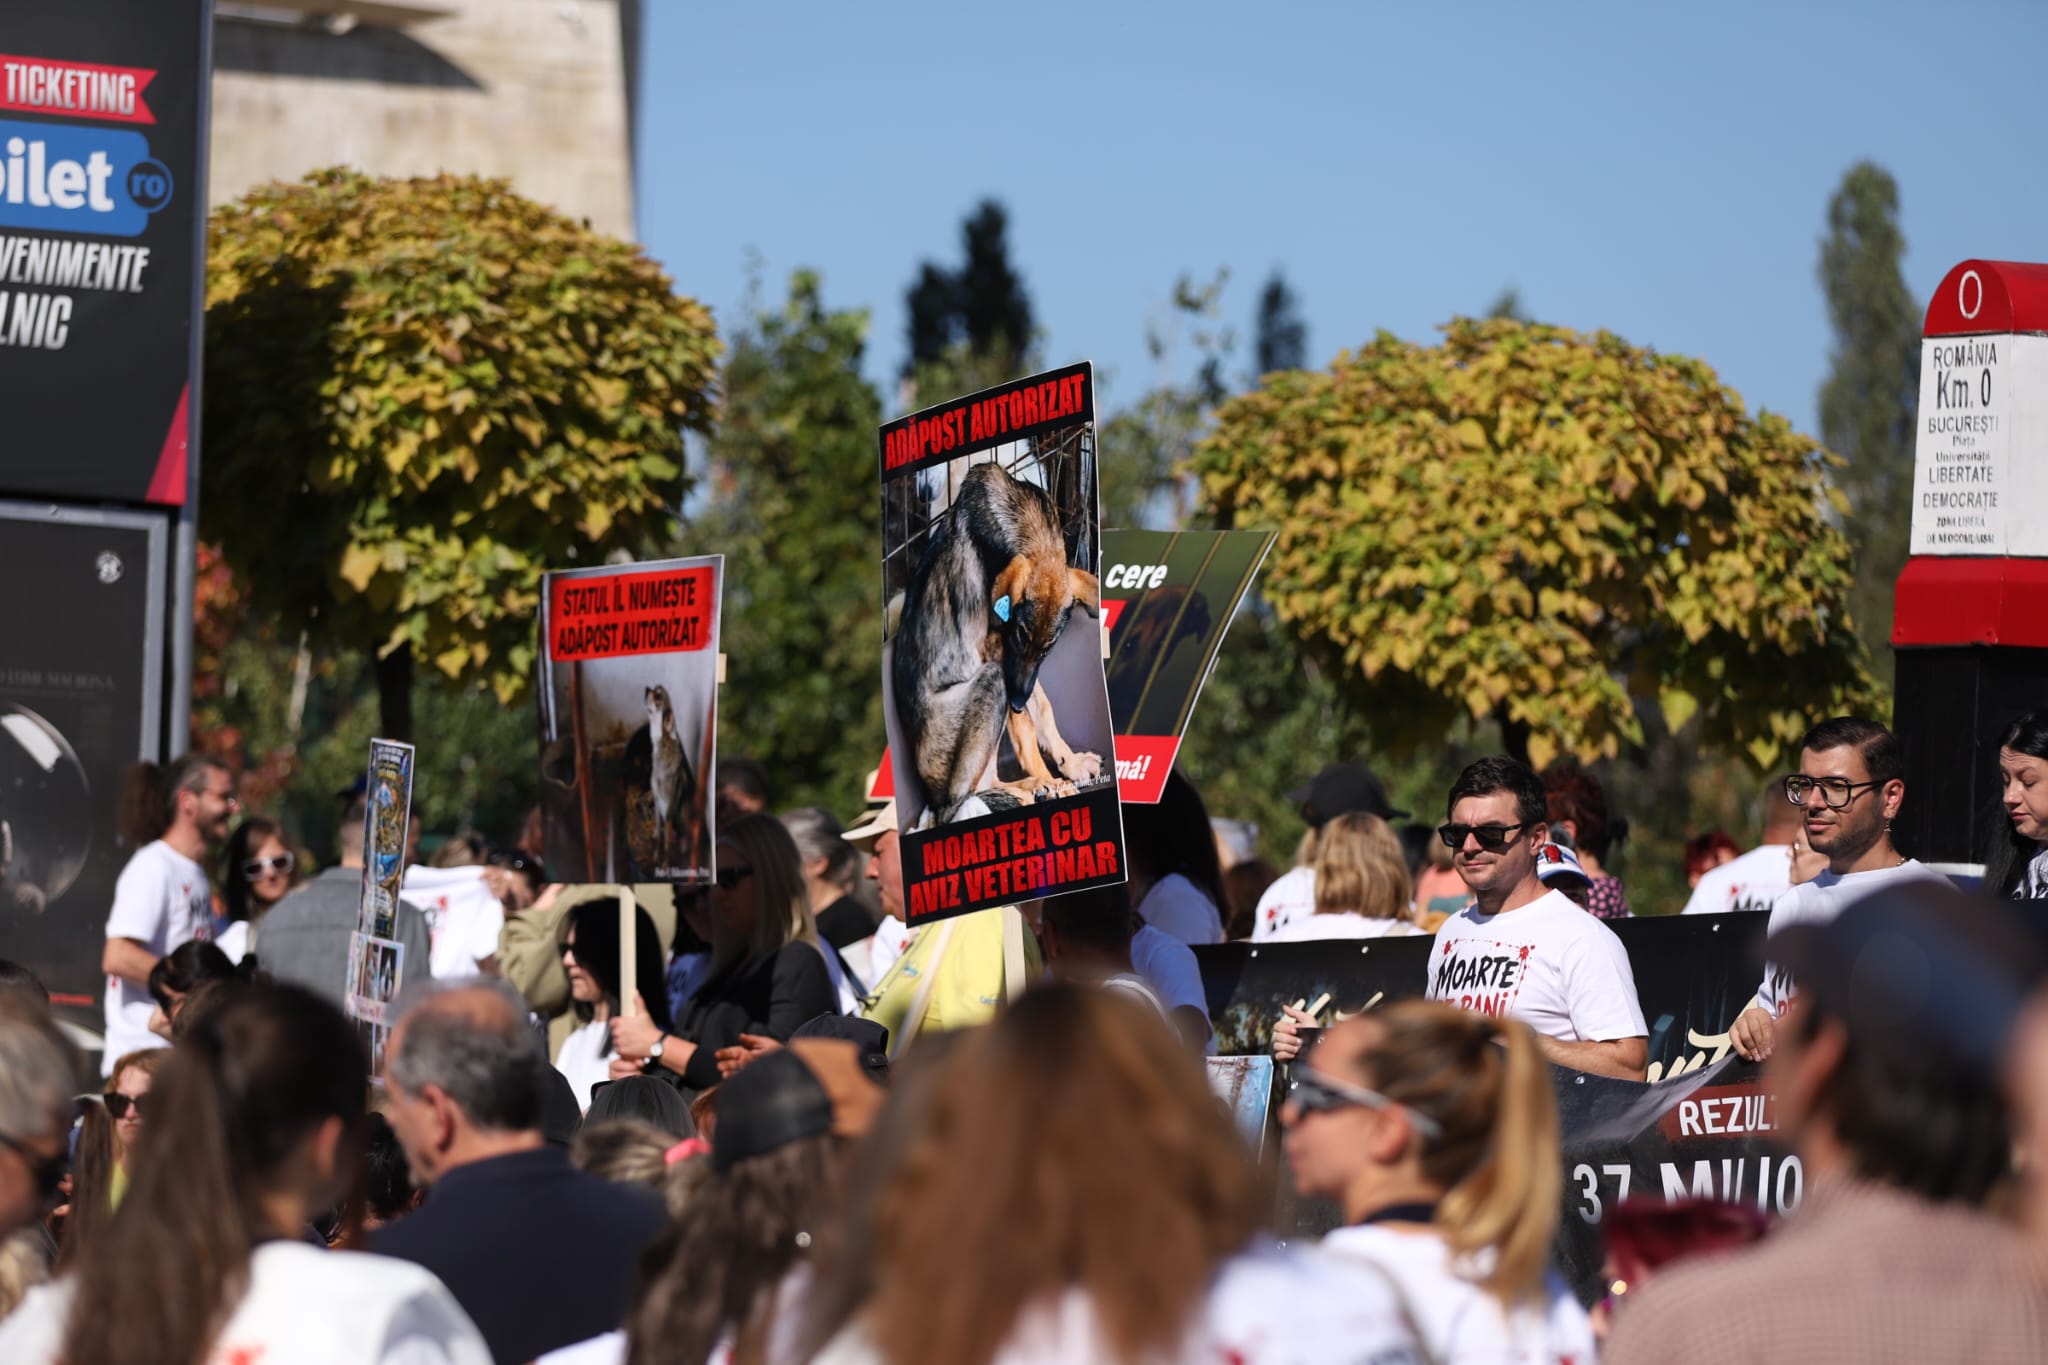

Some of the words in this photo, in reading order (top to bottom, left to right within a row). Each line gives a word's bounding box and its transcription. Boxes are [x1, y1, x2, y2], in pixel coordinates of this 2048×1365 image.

[4, 62, 136, 116] TICKETING
[0, 136, 115, 212] ilet
[132, 172, 165, 199] ro
[1933, 338, 1998, 369] ROMÂNIA
[1981, 368, 1991, 407] 0
[885, 407, 967, 471] ADĂPOST
[970, 373, 1085, 443] AUTORIZAT
[1928, 465, 1993, 484] LIBERTATE
[1105, 563, 1168, 589] cere
[563, 585, 609, 616] STATUL
[557, 619, 618, 655] ADĂPOST
[620, 615, 699, 651] AUTORIZAT
[922, 816, 1046, 876] MOARTEA
[1051, 806, 1092, 846] CU
[910, 874, 961, 917] AVIZ
[964, 841, 1118, 903] VETERINAR
[1435, 952, 1519, 998] MOARTE
[1679, 1095, 1779, 1136] REZUL
[1573, 1163, 1631, 1225] 37
